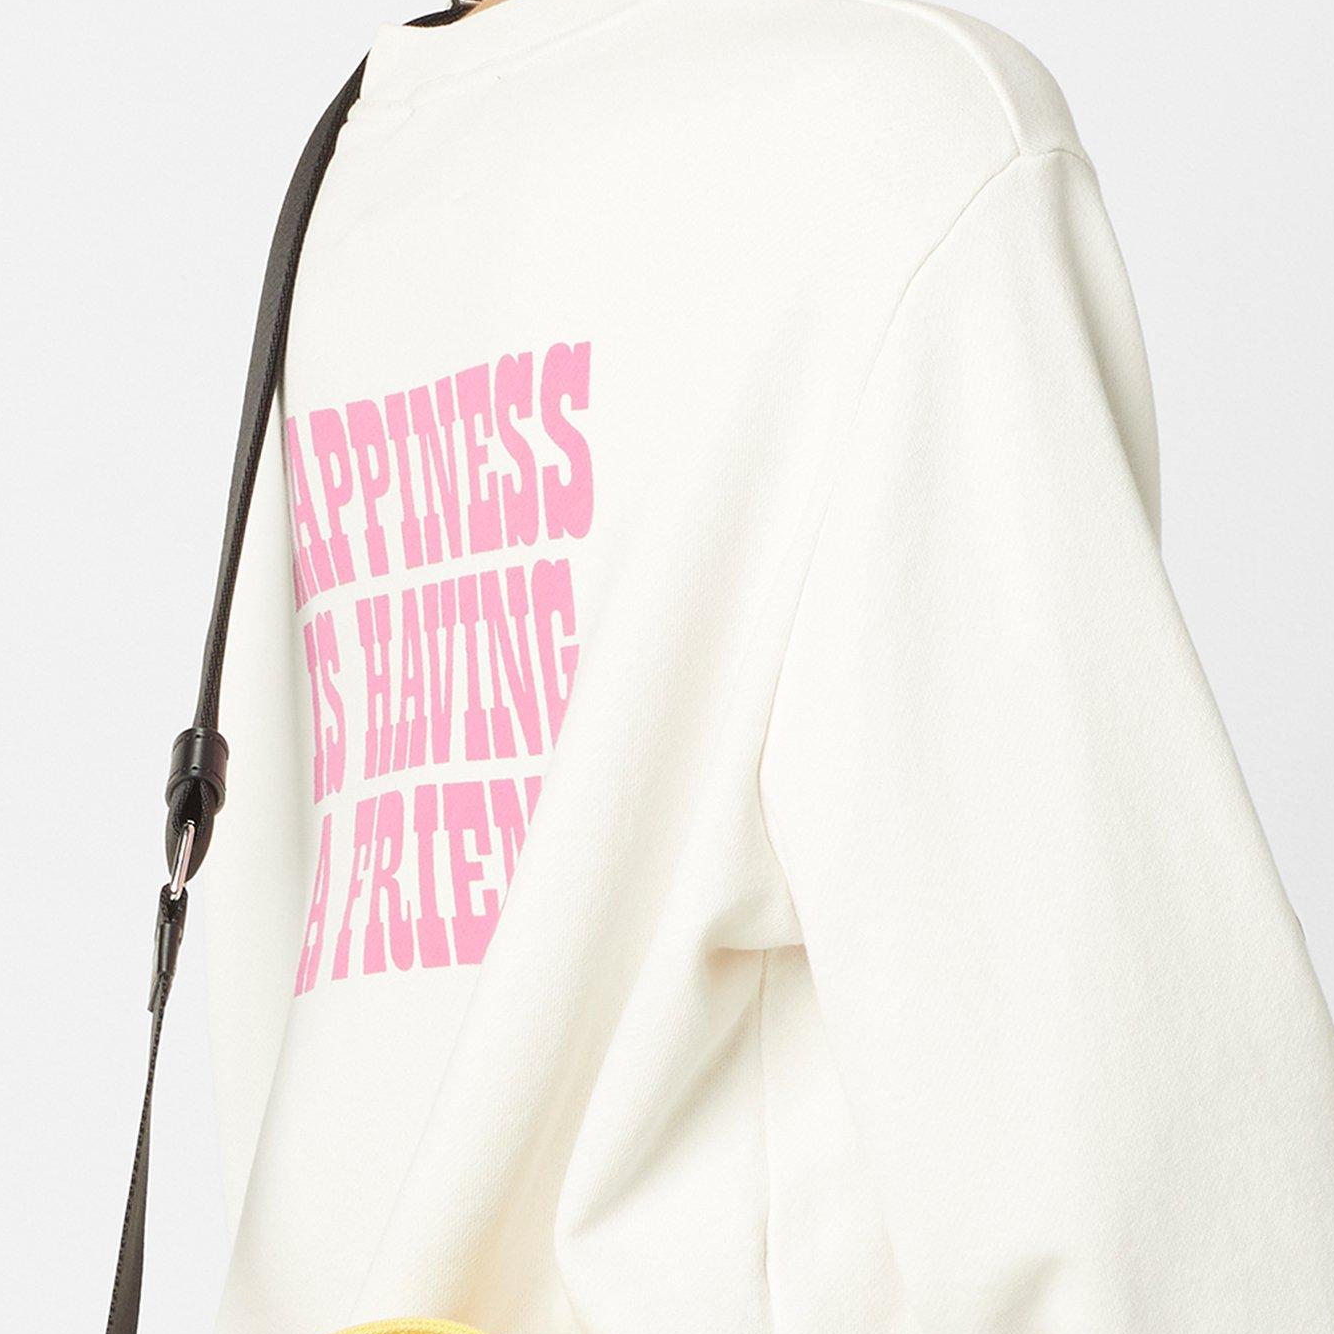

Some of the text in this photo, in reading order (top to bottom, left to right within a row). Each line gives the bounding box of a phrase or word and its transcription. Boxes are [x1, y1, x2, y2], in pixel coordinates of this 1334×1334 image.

[287, 342, 594, 613] APPINESS
[303, 557, 580, 805] IS HAVING
[294, 813, 332, 998] A
